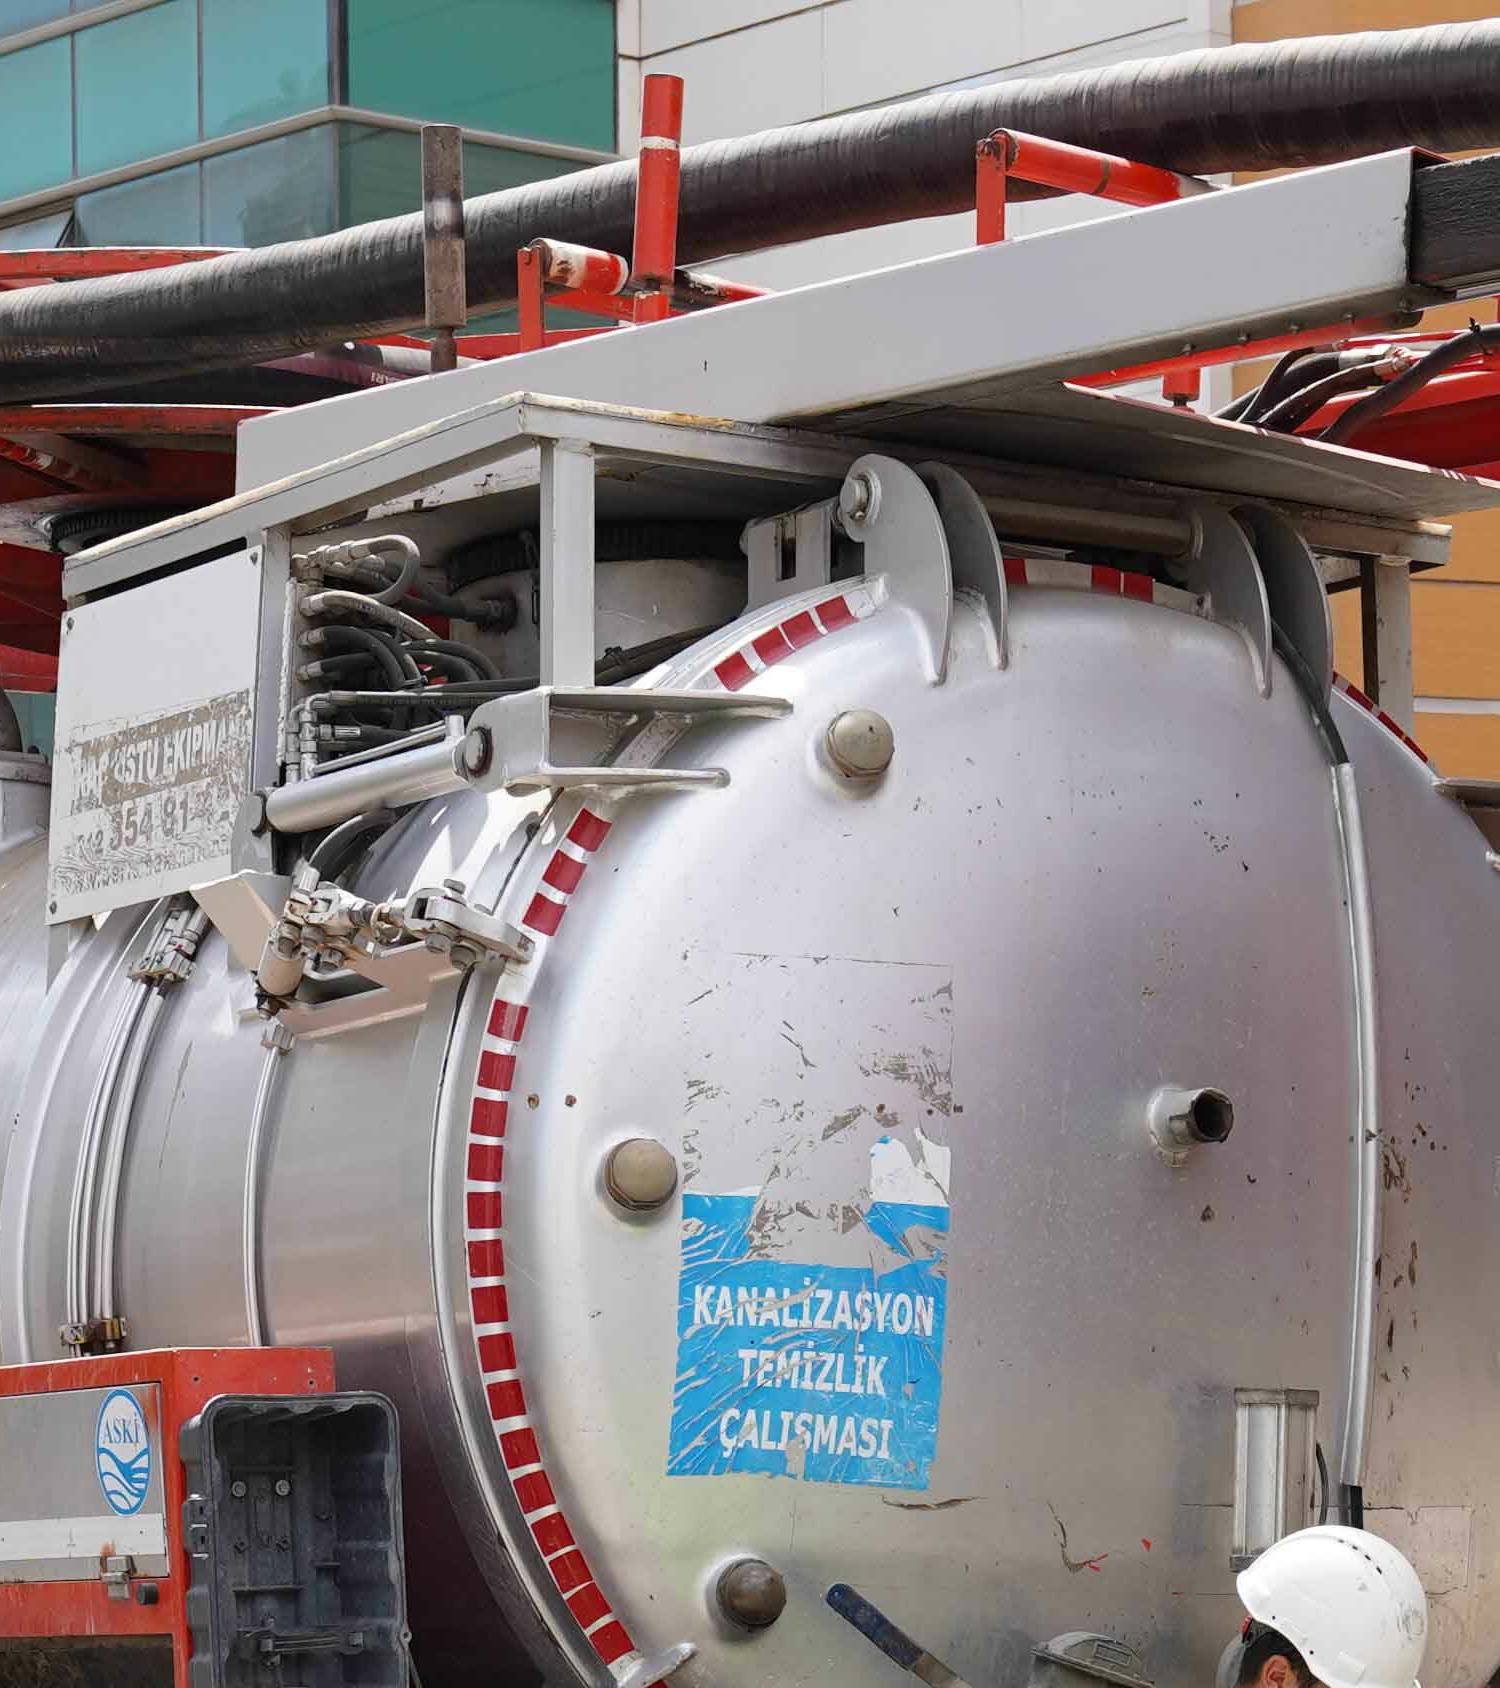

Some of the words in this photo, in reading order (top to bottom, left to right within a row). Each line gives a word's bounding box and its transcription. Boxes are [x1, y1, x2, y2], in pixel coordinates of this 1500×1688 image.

[692, 1277, 935, 1337] KANALİZASYON
[738, 1341, 888, 1396] TEMİZLİK
[102, 1412, 141, 1445] ASKİ
